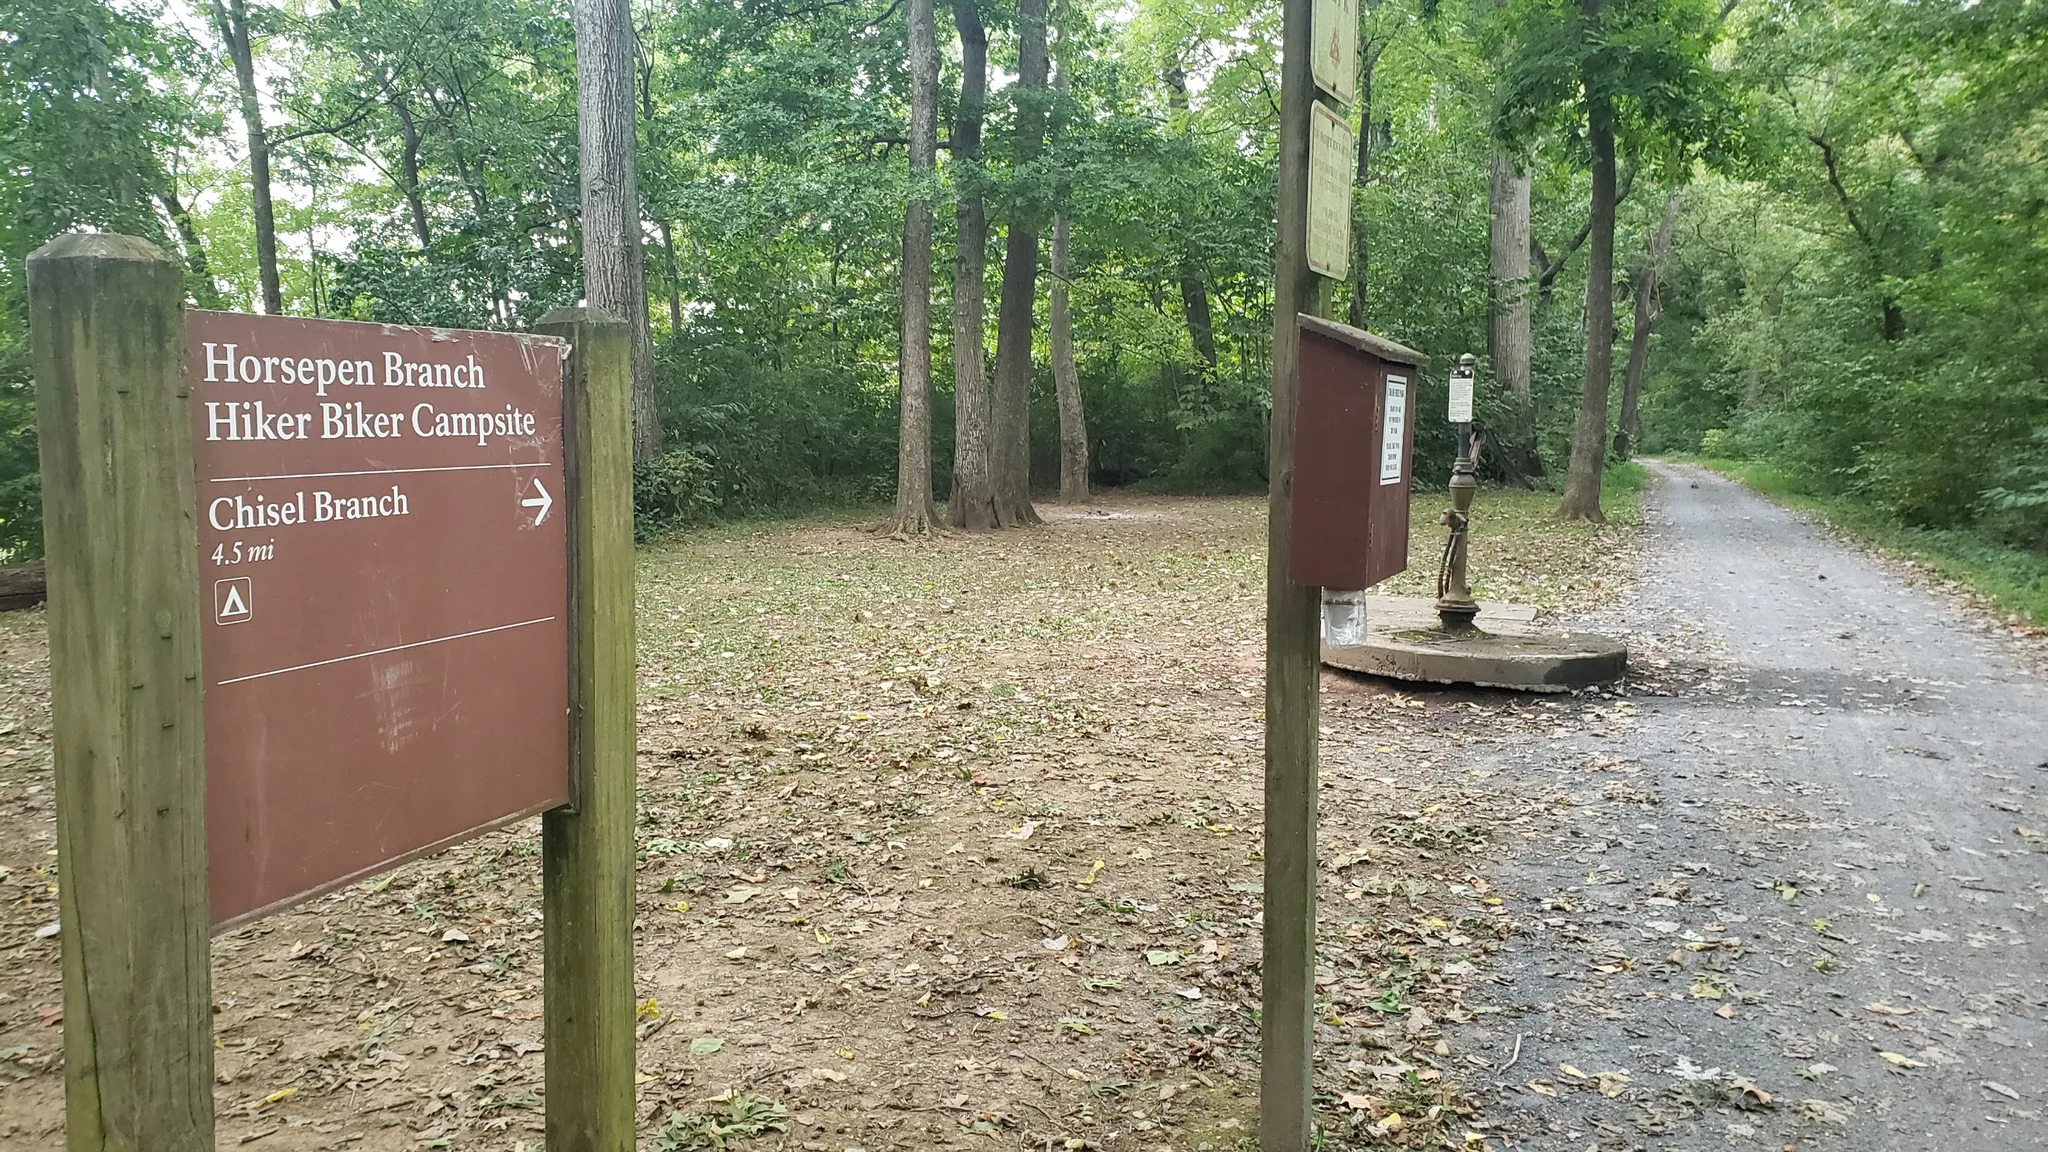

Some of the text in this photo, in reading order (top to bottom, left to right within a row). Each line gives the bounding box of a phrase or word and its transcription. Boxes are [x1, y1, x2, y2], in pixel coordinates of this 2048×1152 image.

[203, 342, 486, 396] Horsepen Branch
[205, 401, 536, 446] Hiker Biker Campsite
[208, 485, 409, 532] Chisel Branch
[211, 539, 275, 566] 4.5 mi
